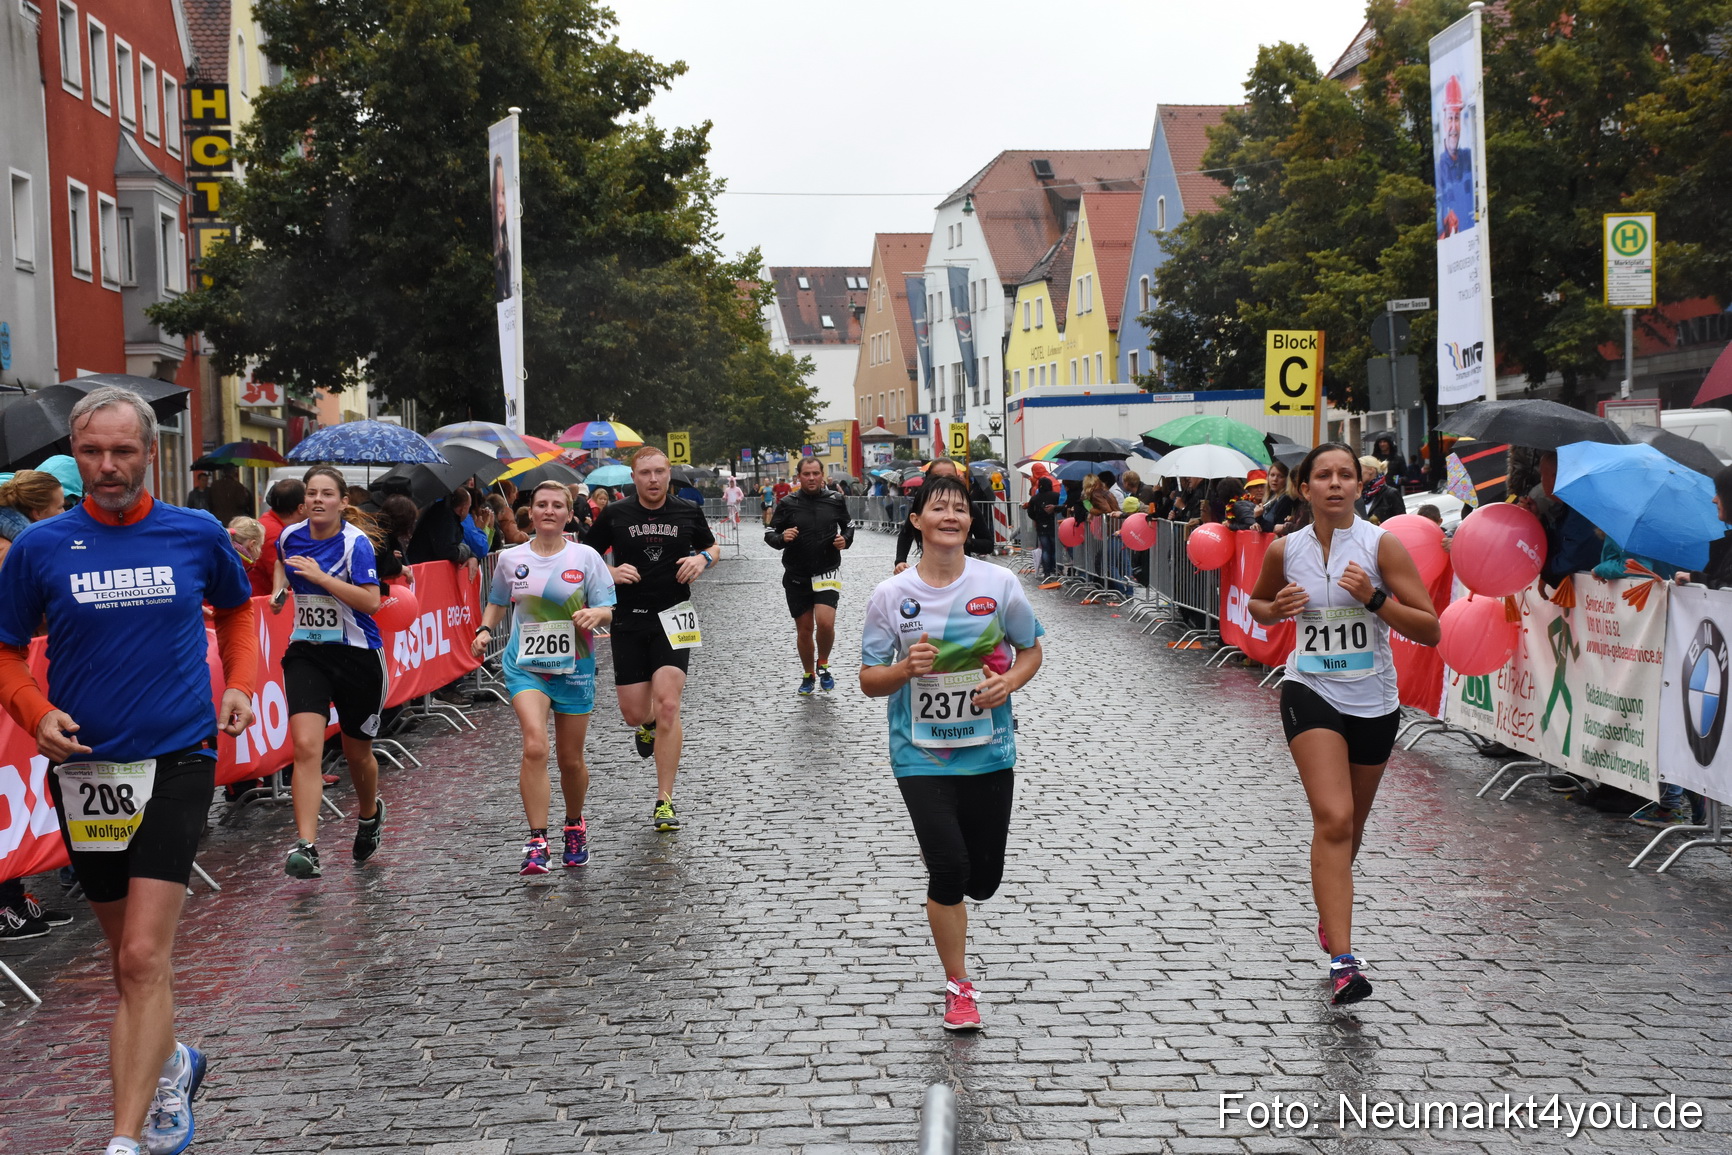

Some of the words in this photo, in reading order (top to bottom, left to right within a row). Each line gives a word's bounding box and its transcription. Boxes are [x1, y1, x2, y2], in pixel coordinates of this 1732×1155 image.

[1411, 300, 1428, 308] Gasse
[1273, 334, 1317, 350] Block
[1031, 346, 1045, 360] HOTEL
[1279, 356, 1308, 398] C
[954, 433, 964, 449] D
[674, 442, 685, 458] D
[628, 523, 679, 538] FLORIDA
[70, 566, 175, 593] HUBER
[94, 586, 171, 600] TECHNOLOGY
[95, 601, 118, 610] WASTE
[120, 599, 144, 608] WATER
[145, 598, 172, 606] Solutions
[969, 602, 995, 612] Hervis
[298, 607, 338, 628] 2633
[1326, 607, 1366, 619] BOCK
[672, 611, 695, 630] 178
[900, 621, 923, 630] PARTL
[306, 632, 322, 640] Jana
[901, 626, 924, 634] Neumarkt
[1304, 622, 1367, 651] 2110
[524, 634, 570, 655] 2266
[1688, 622, 1728, 673] BMW
[531, 660, 561, 668] Simone
[1323, 658, 1347, 669] Nina
[944, 672, 981, 685] BOCK
[931, 725, 975, 740] Krystyna
[96, 763, 146, 775] BOCK
[79, 782, 137, 816] 208
